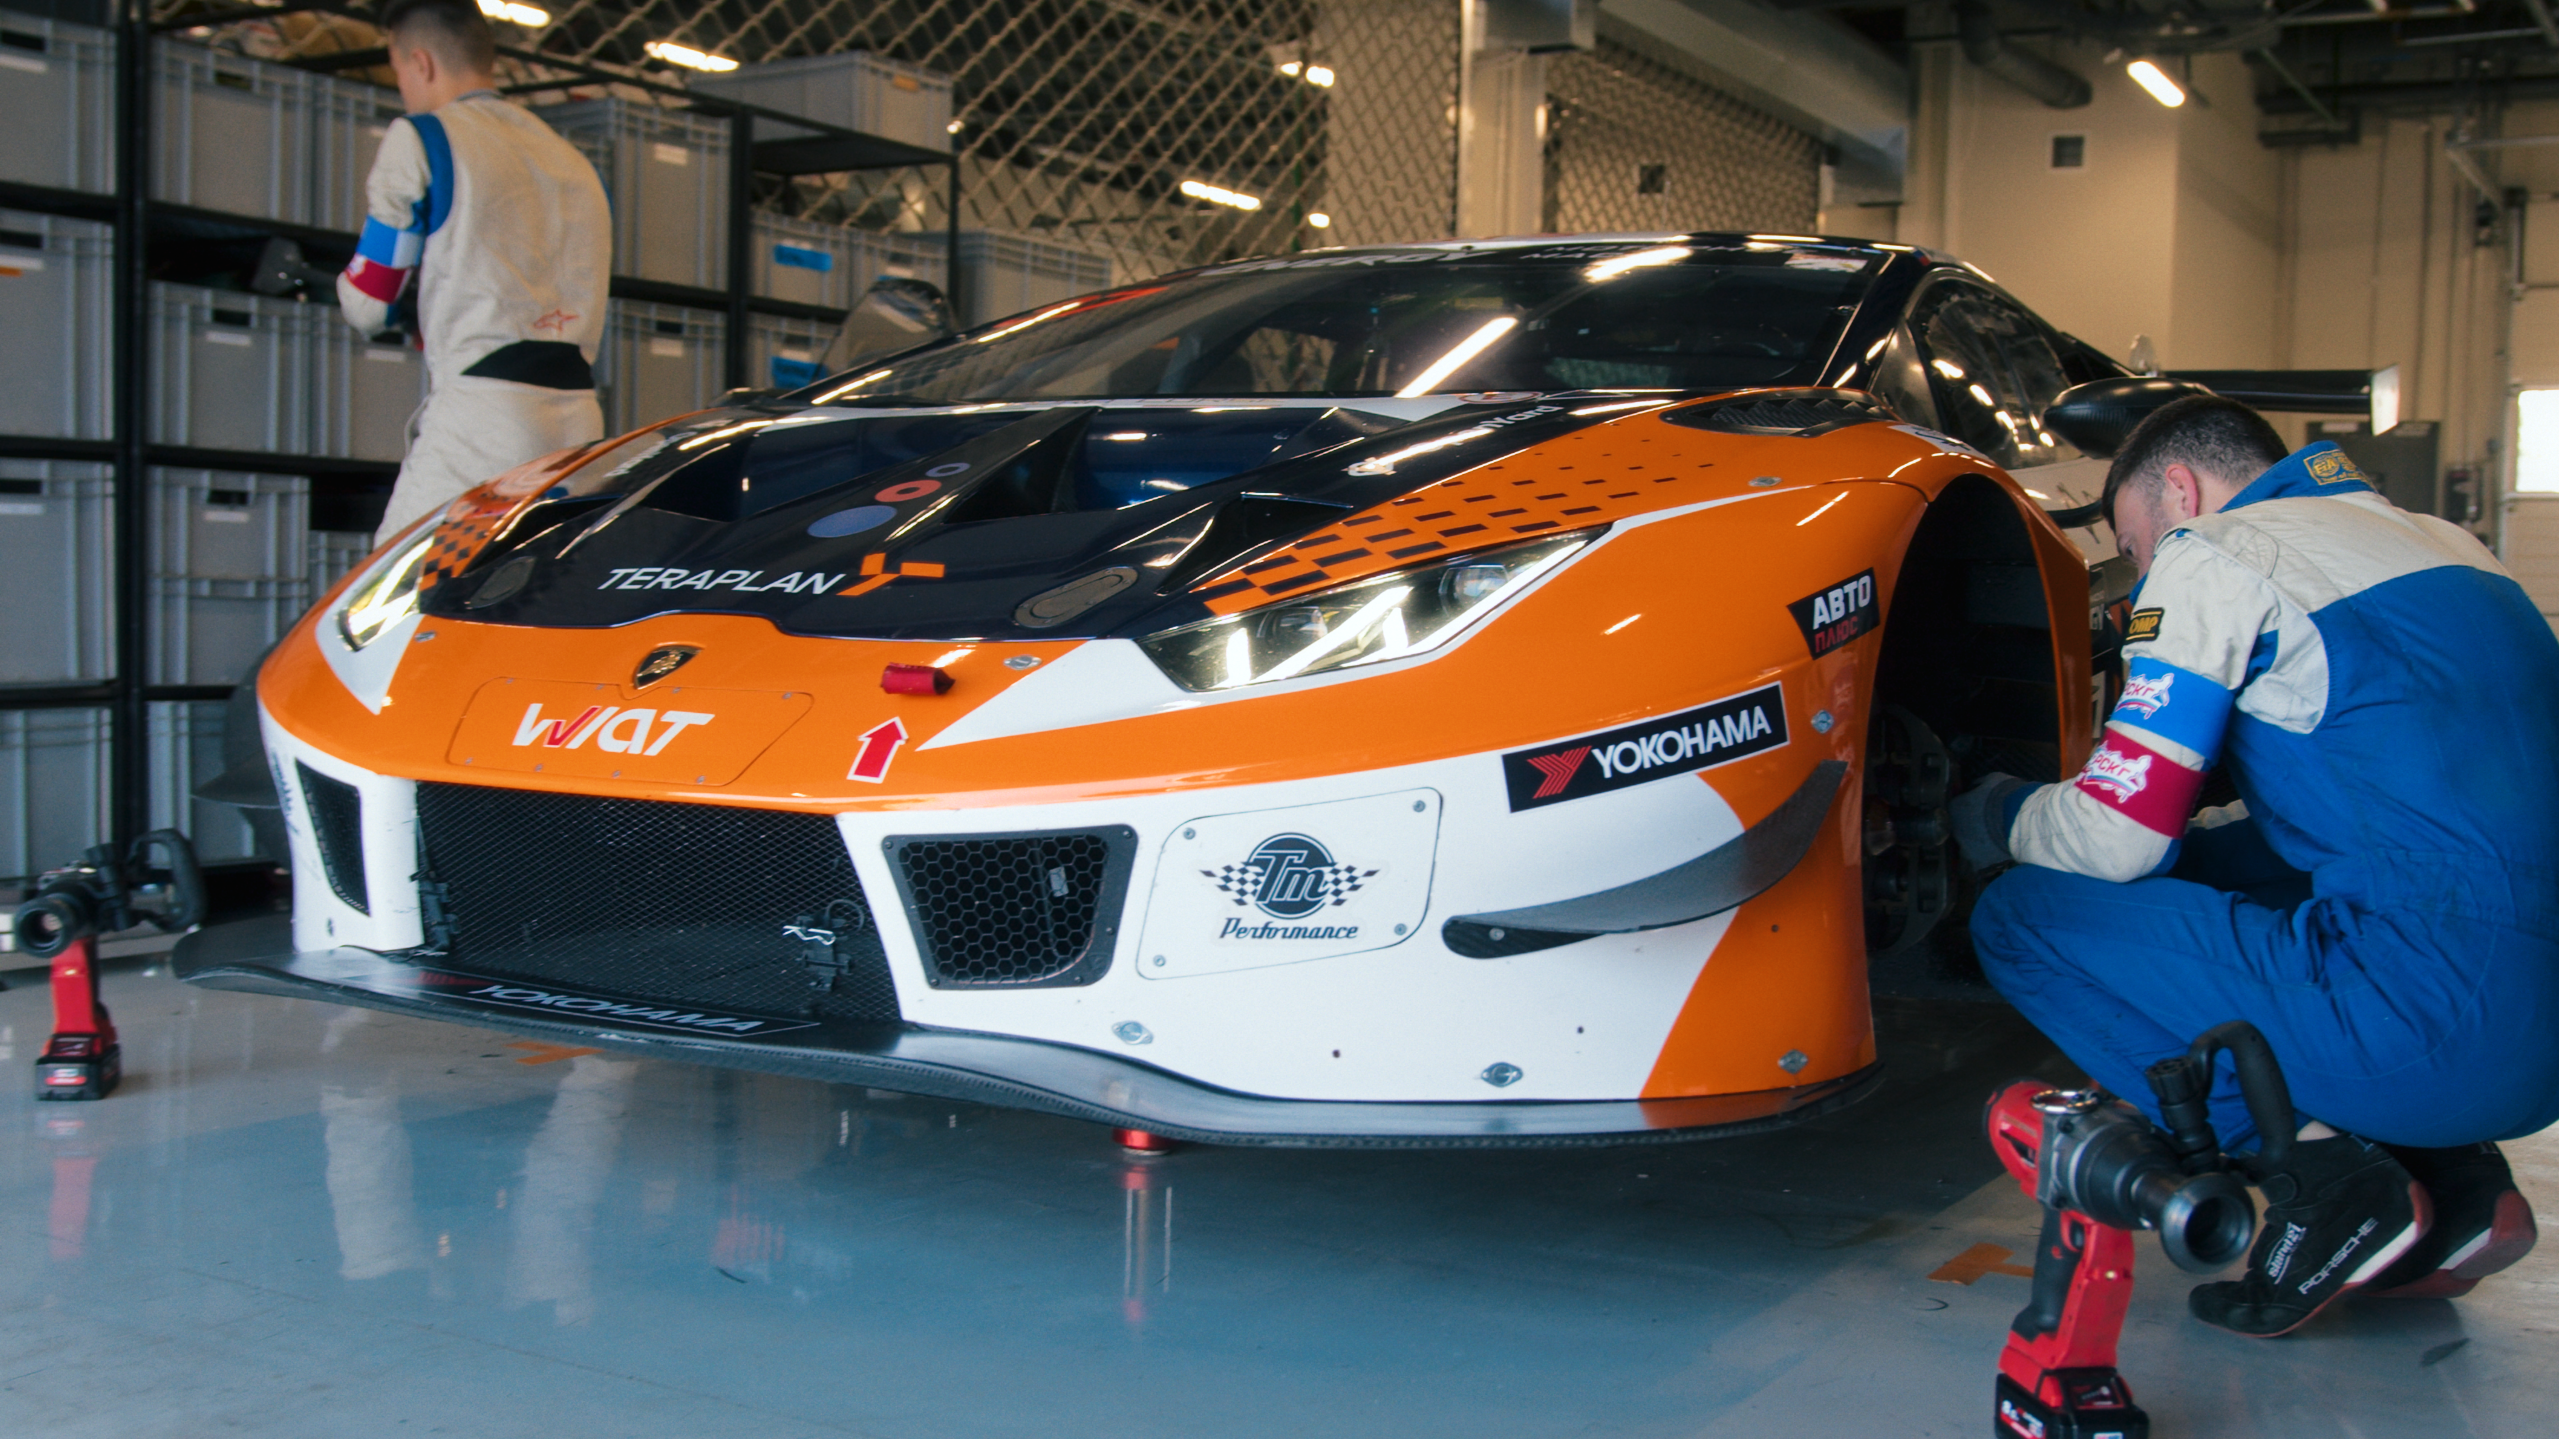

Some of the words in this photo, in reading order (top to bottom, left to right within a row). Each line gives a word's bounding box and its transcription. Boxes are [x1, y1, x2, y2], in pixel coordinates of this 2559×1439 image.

[597, 567, 847, 595] TERAPLAN
[1812, 574, 1871, 630] АВТО
[1814, 615, 1858, 653] ПЛЮС
[2129, 616, 2159, 634] OMP
[1591, 705, 1772, 779] YOKOHAMA
[2093, 753, 2131, 776] РСКГ
[1219, 917, 1359, 940] Performance
[468, 984, 766, 1031] YOKOHAMA
[2297, 1217, 2379, 1295] PORSCHE
